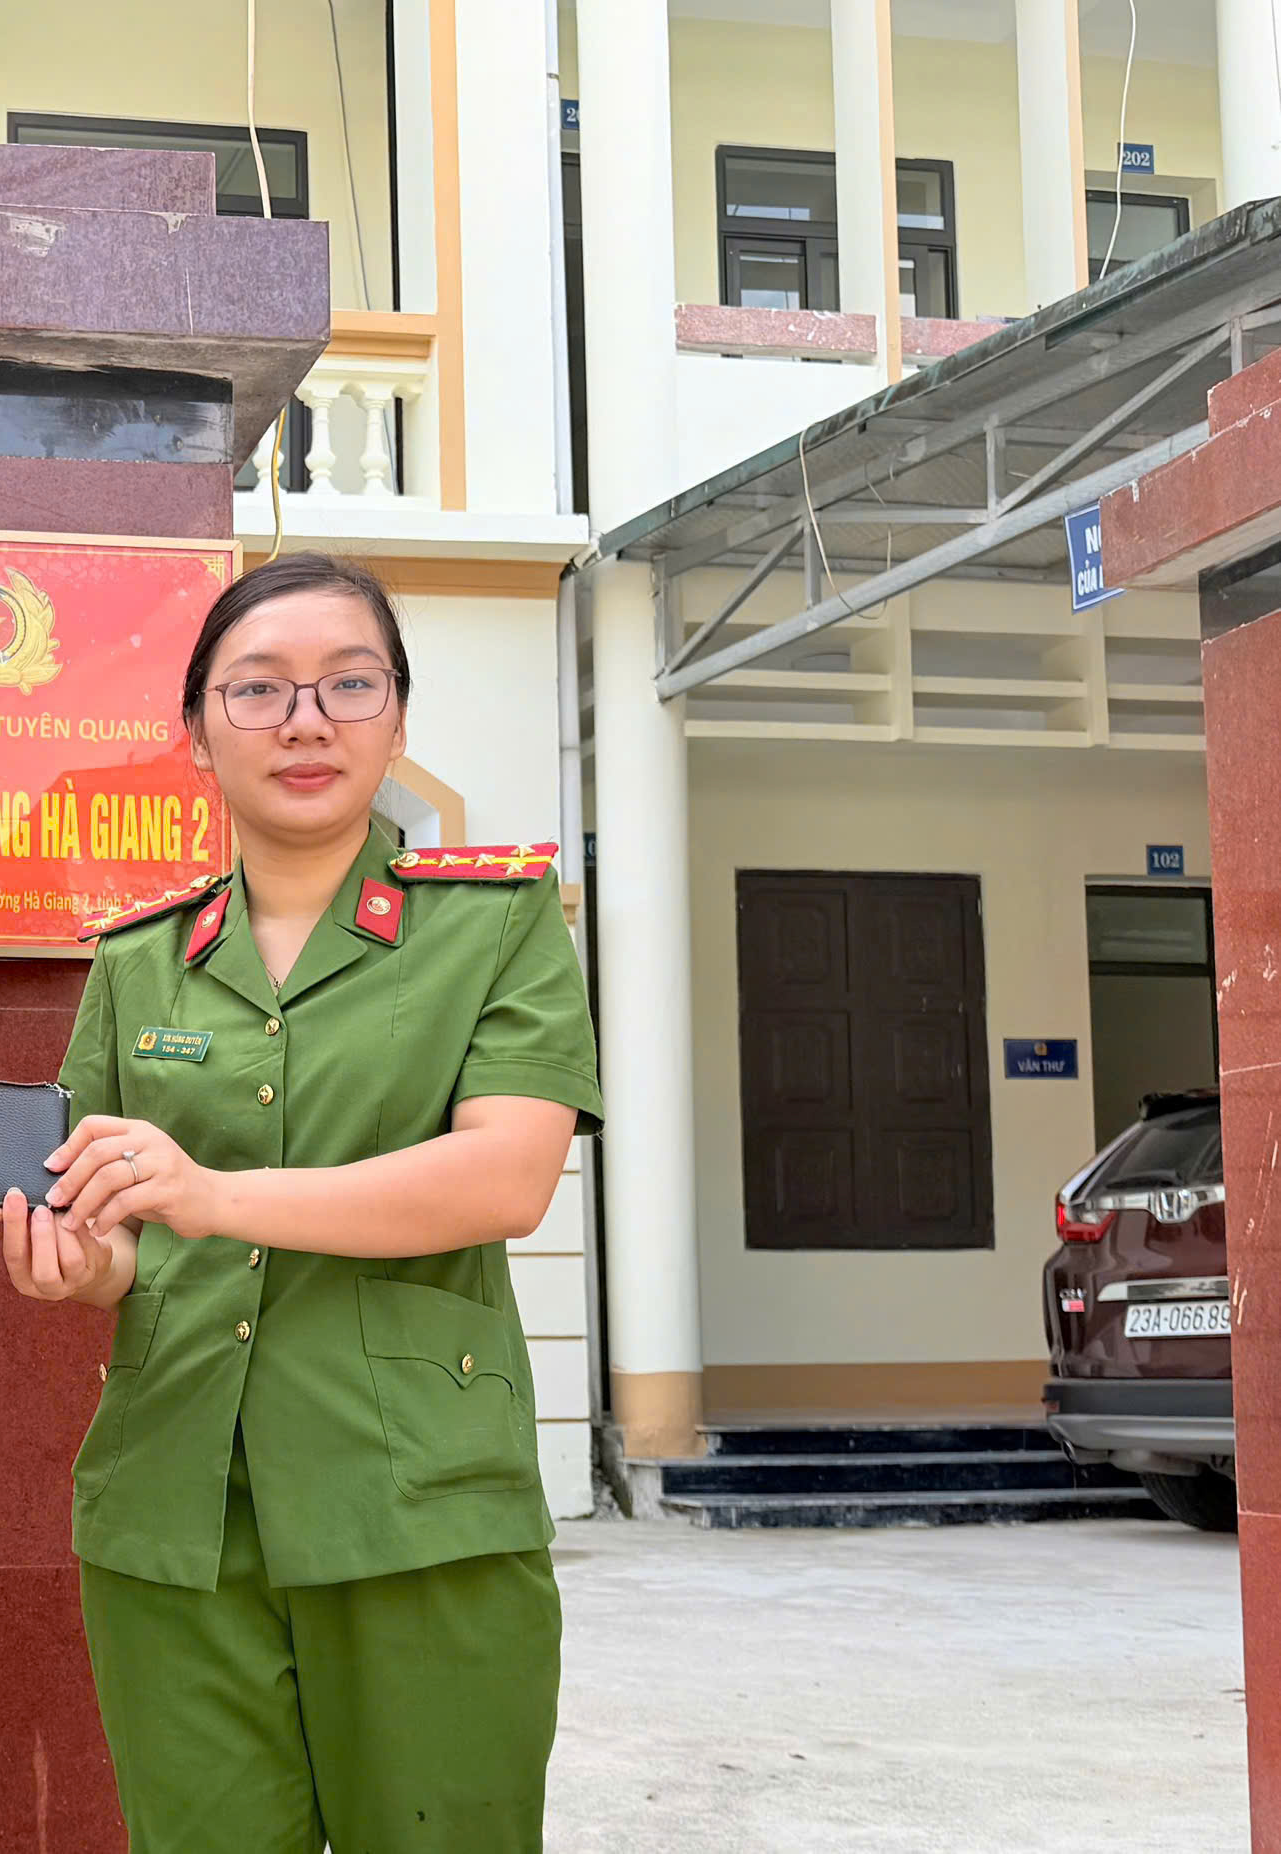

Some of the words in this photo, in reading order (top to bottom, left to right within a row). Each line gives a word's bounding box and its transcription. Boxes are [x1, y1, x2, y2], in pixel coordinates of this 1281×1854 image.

[1123, 150, 1150, 167] 202
[78, 718, 168, 743] QUANG
[41, 778, 81, 860] HÀ
[90, 792, 182, 862] GIANG
[191, 797, 209, 863] 2
[1152, 852, 1180, 869] 102
[24, 888, 40, 910] Hà
[43, 891, 79, 915] Giang
[1042, 1060, 1065, 1073] THƯ
[1129, 1304, 1231, 1333] 23A-066.89
